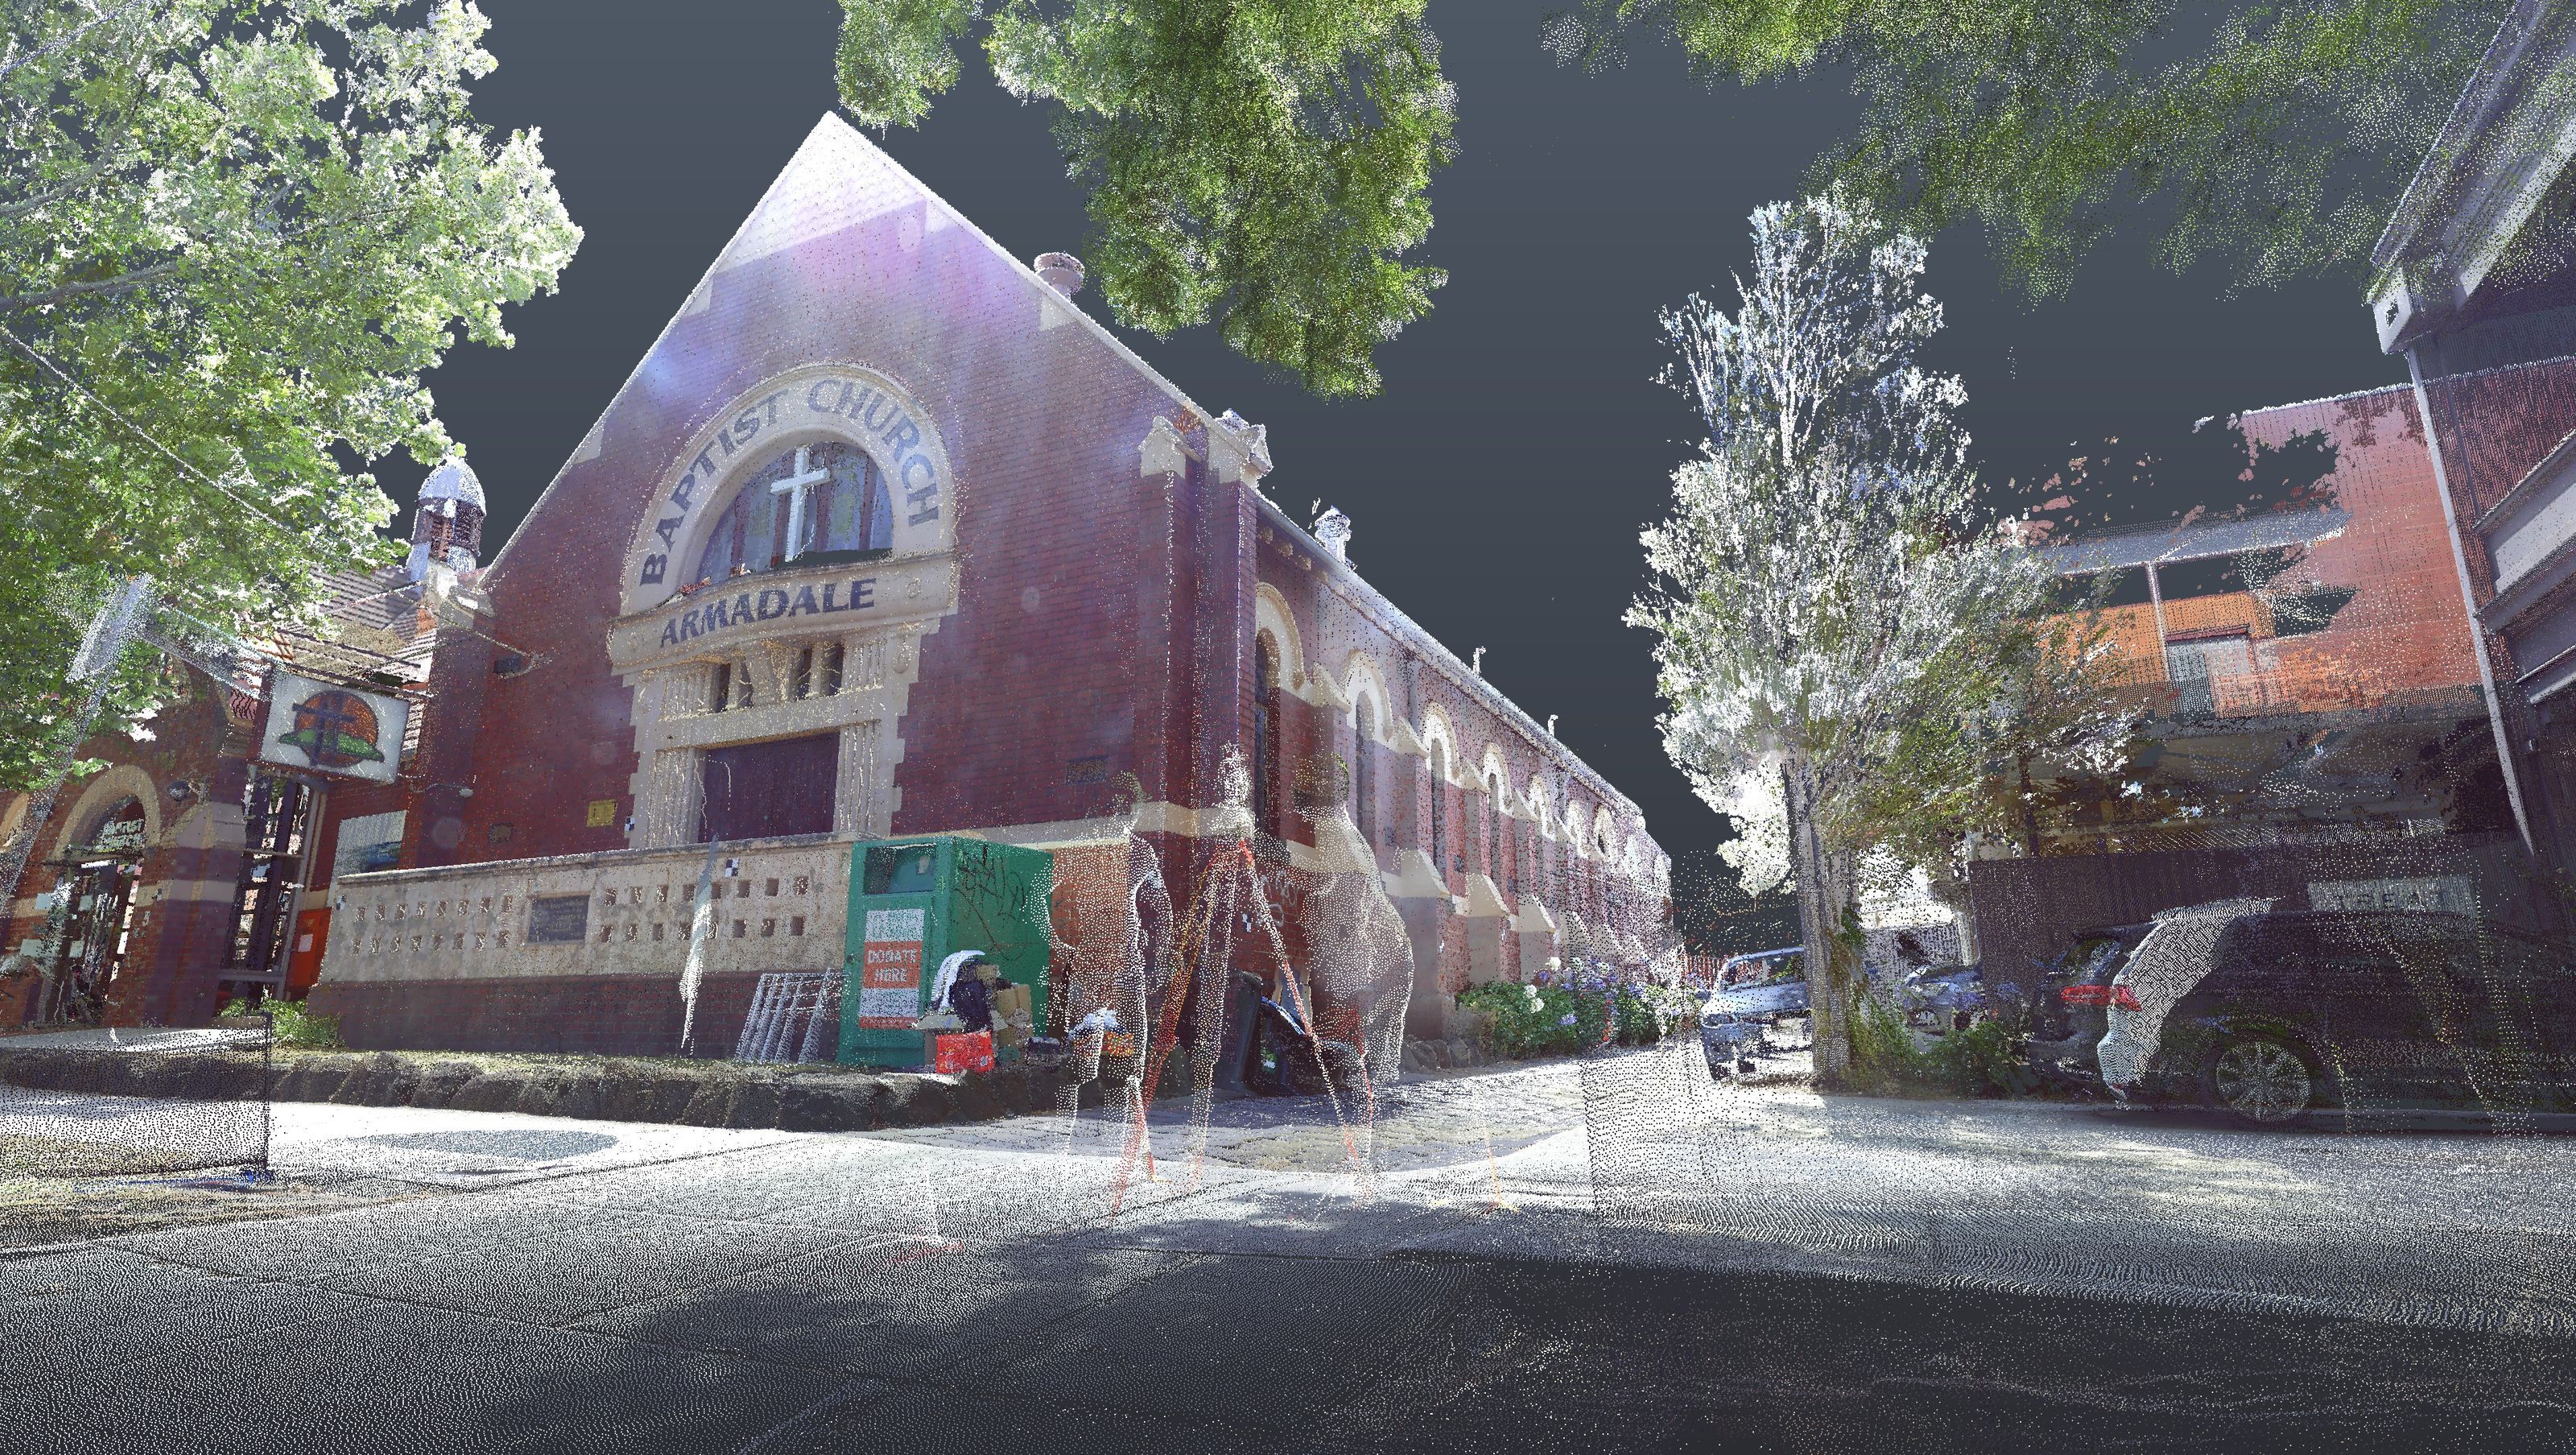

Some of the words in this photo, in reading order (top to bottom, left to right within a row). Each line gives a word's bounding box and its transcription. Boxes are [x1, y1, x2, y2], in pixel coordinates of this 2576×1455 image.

[639, 389, 788, 586] BAPTIST
[807, 379, 940, 527] CHURCH
[659, 578, 877, 648] ARMADALE
[868, 949, 917, 964] DONATE
[874, 968, 908, 982] HERE
